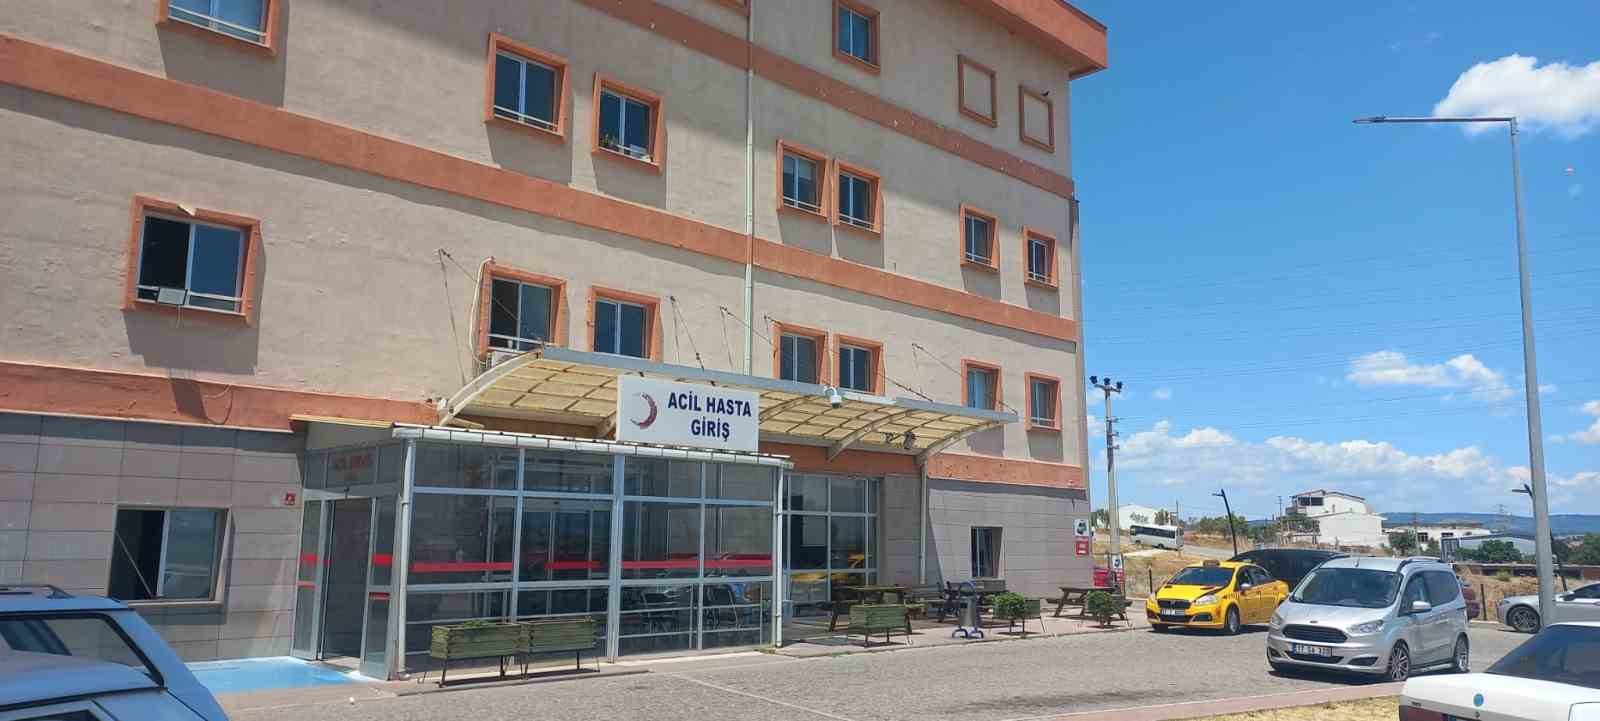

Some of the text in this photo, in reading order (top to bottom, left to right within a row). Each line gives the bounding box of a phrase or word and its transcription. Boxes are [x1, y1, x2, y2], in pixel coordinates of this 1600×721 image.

[668, 391, 751, 416] ACİL HASTA
[691, 416, 730, 442] GİRİŞ
